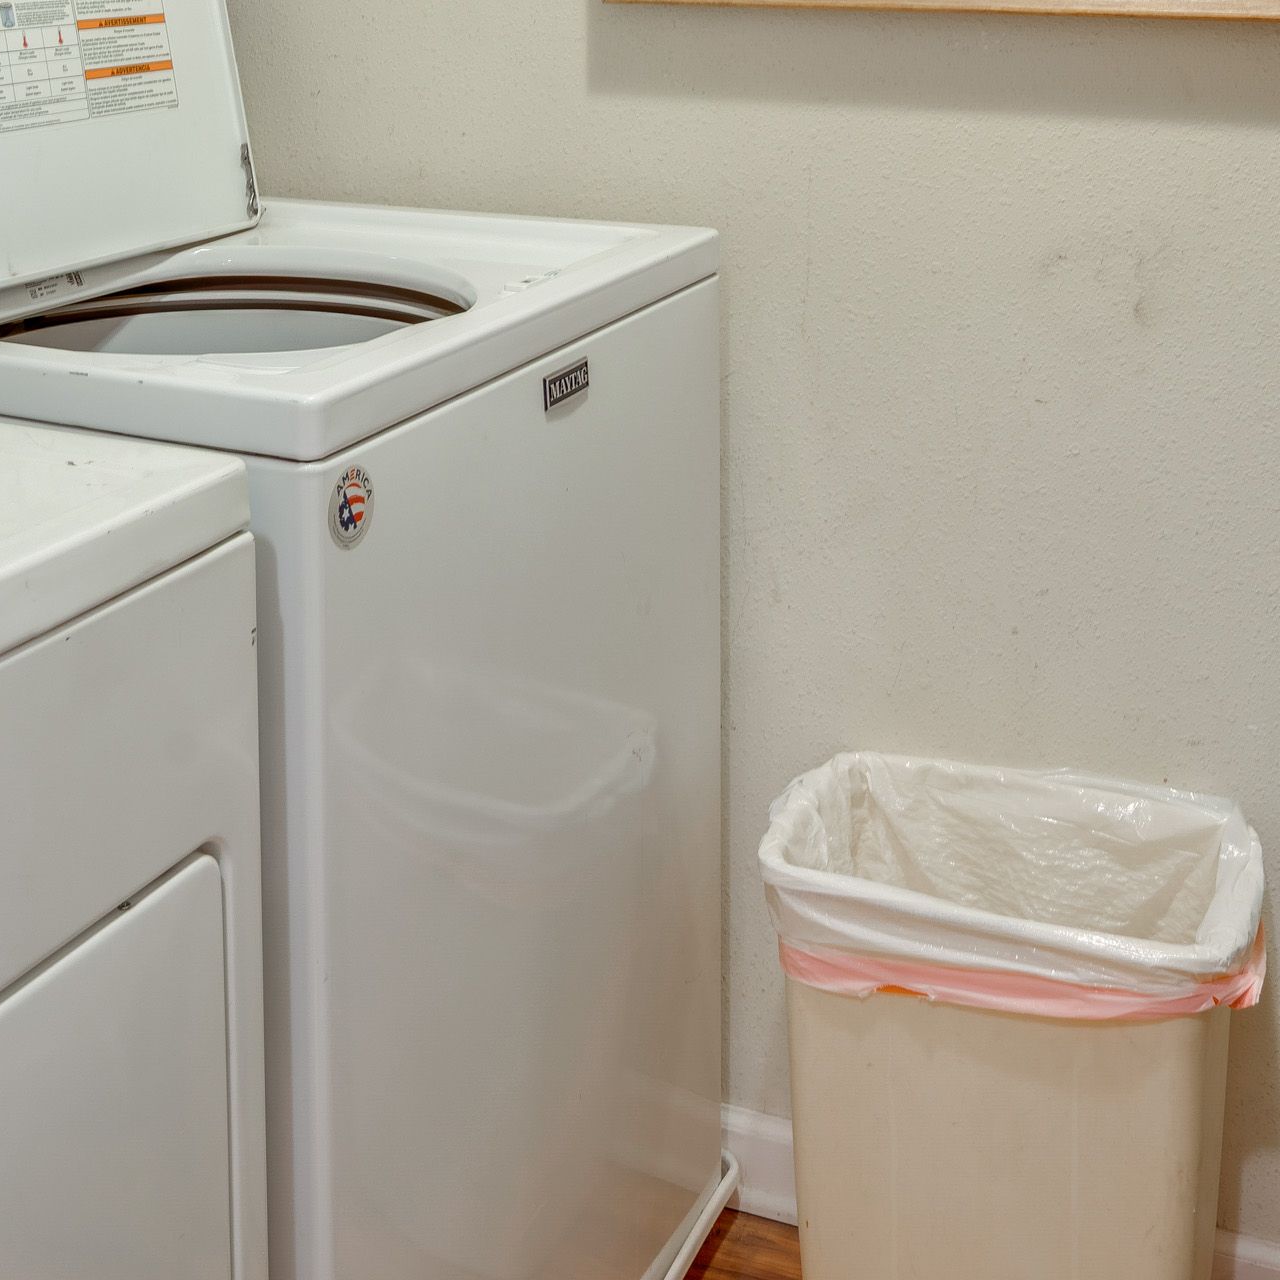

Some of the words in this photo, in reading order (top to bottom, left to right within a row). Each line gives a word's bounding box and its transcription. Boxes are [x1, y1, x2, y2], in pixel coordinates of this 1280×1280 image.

[115, 64, 151, 75] ADVERTENCIA
[549, 367, 589, 402] MAYTAG
[336, 468, 373, 501] AMERICA
